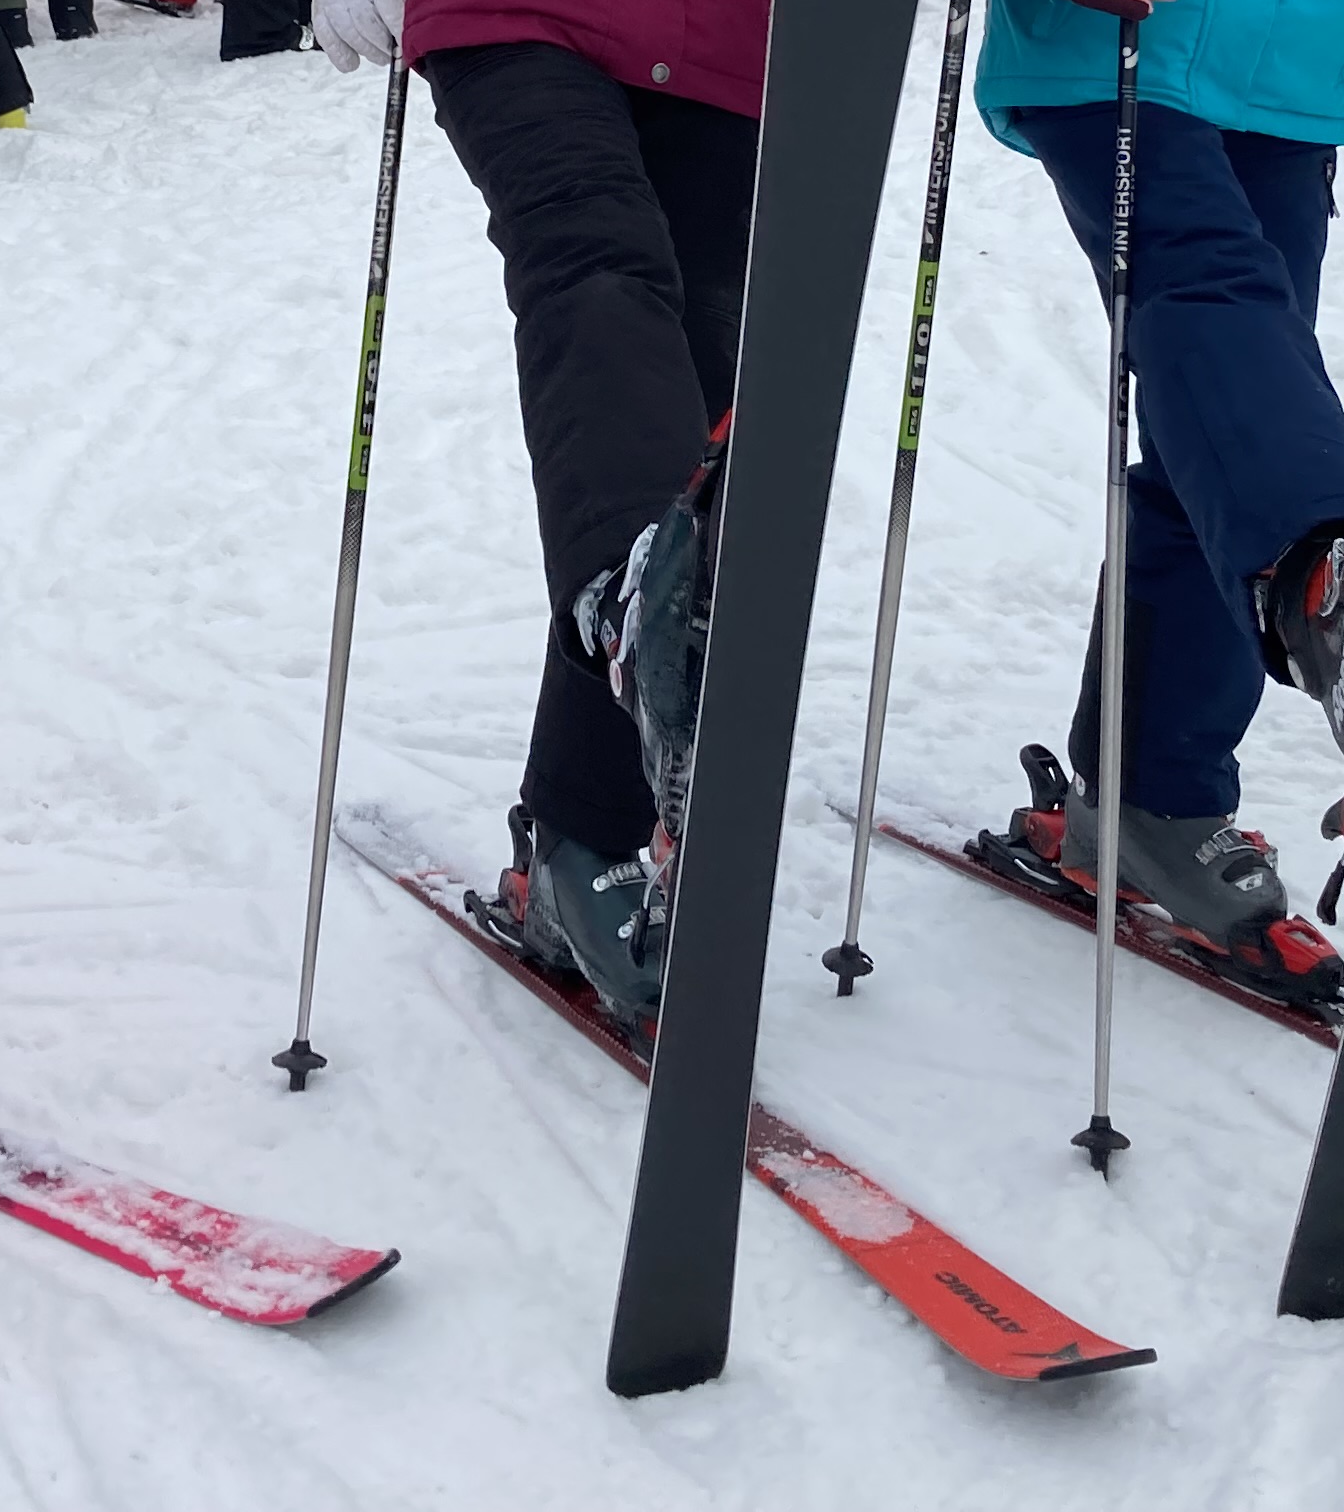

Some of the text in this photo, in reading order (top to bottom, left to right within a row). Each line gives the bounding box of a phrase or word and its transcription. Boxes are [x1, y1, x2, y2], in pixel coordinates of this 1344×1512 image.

[373, 128, 397, 259] INTERSPORT
[1113, 124, 1132, 252] INTERSPORT
[911, 322, 930, 390] 110
[934, 1271, 1028, 1334] ATOMIC
